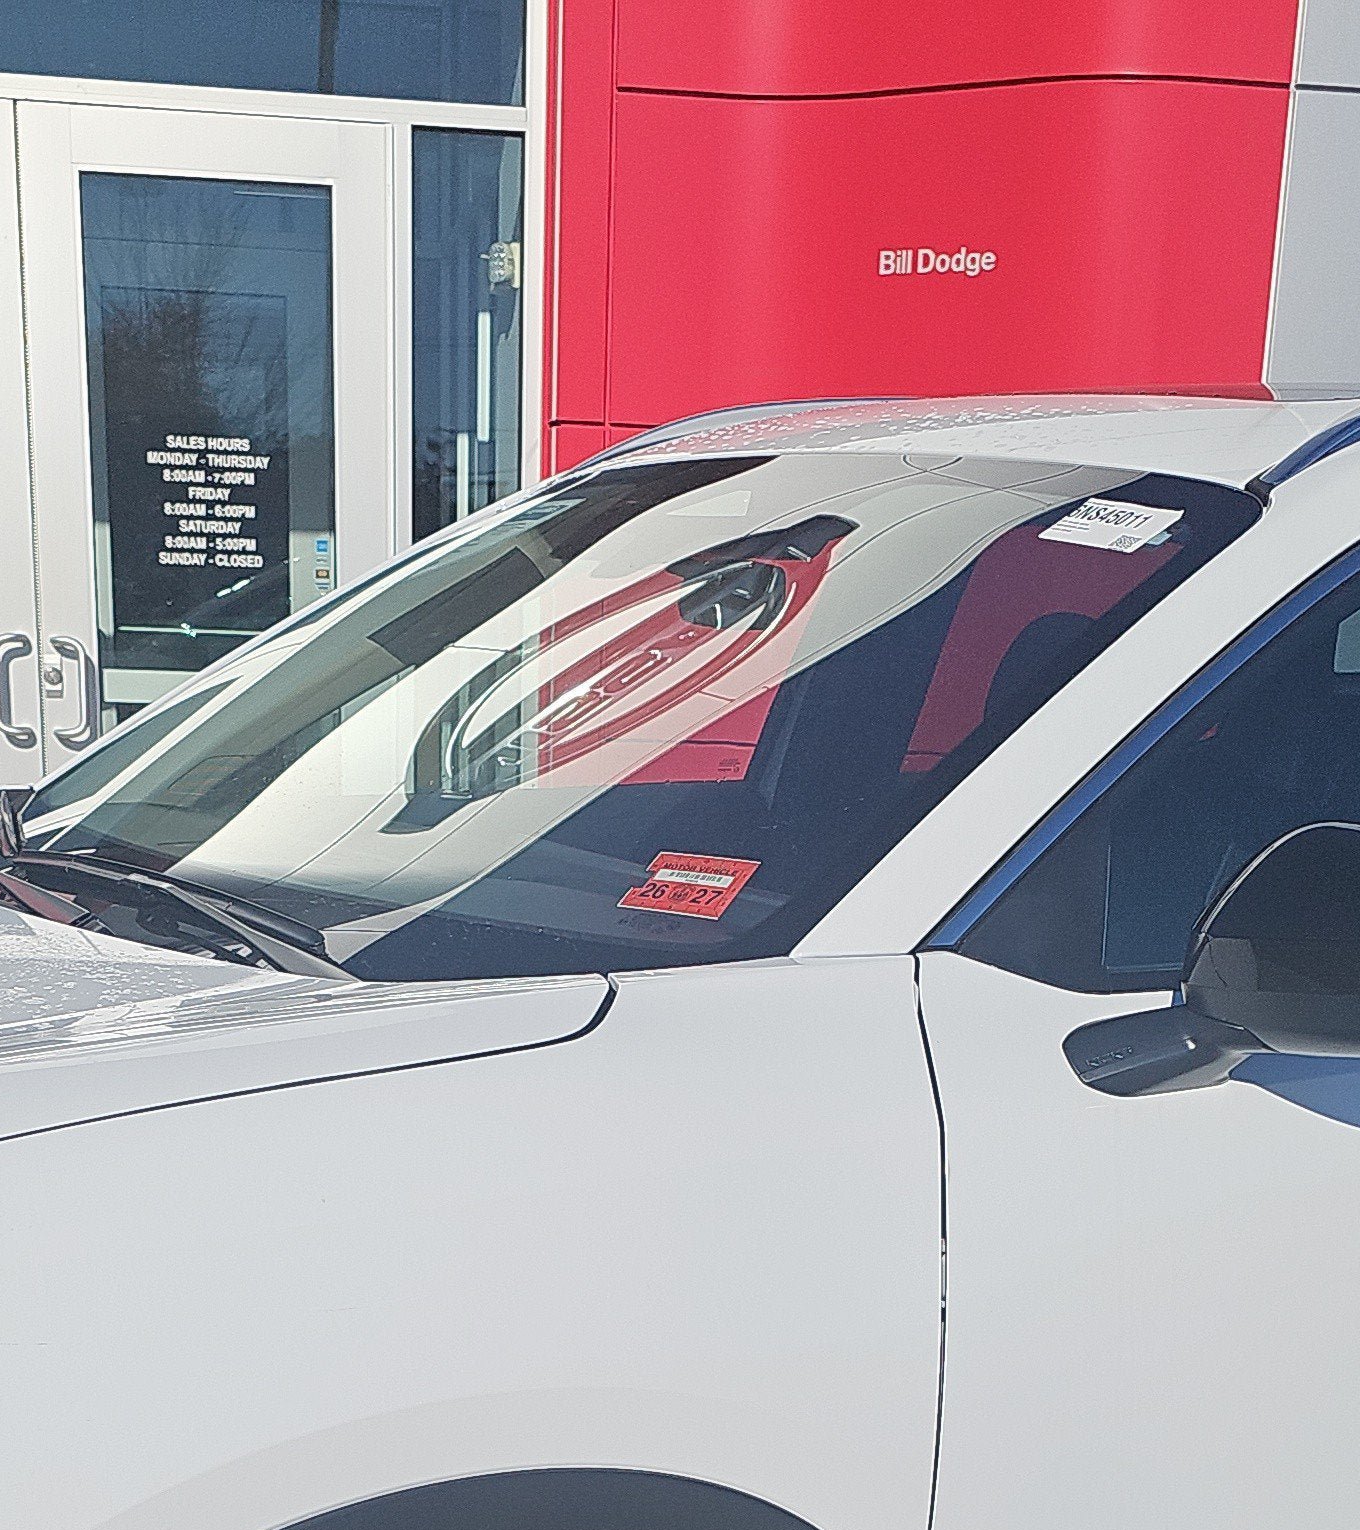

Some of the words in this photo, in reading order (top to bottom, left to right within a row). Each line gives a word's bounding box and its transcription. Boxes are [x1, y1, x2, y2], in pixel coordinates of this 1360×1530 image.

[879, 249, 913, 275] Bill
[917, 246, 997, 276] Dodge
[165, 435, 207, 450] SALES
[207, 437, 251, 452] HOURS
[146, 451, 199, 466] MONDAY
[206, 454, 271, 469] THURSDAY
[162, 469, 206, 483] 8:00AM
[213, 472, 256, 485] 7:00PM
[187, 487, 232, 501] FRIDAY
[163, 502, 207, 516] 8:00AM
[214, 505, 257, 518] 6:00PM
[1068, 504, 1154, 529] 6NS45011
[178, 520, 242, 534] SATURDAY
[164, 536, 208, 550] 8:00AM
[215, 538, 258, 552] 5:00PM
[158, 552, 208, 566] SUNDAY
[214, 554, 264, 568] CLOSED
[663, 862, 698, 871] MOTOR
[699, 865, 738, 877] VEHICLE
[637, 882, 670, 899] 26
[689, 888, 724, 905] 27
